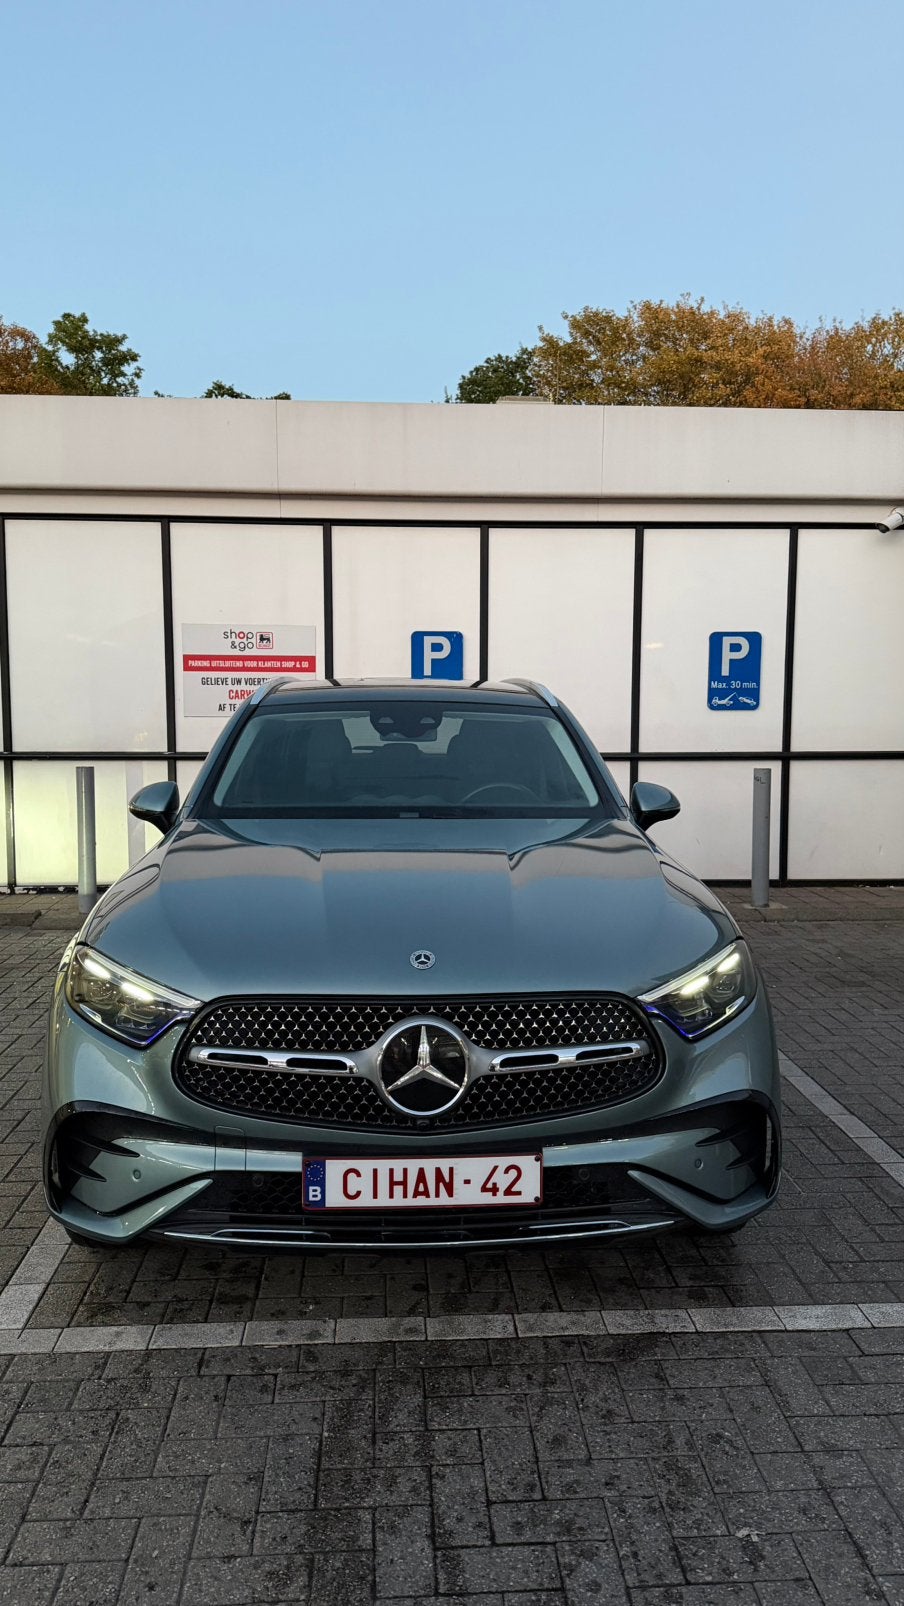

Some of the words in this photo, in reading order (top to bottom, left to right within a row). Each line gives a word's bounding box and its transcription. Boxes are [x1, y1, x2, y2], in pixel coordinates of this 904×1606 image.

[223, 629, 254, 641] shop
[230, 641, 254, 652] &go
[424, 636, 451, 676] P
[721, 636, 750, 676] P
[211, 660, 244, 668] UITSLUITEND
[201, 677, 229, 686] GELIEVE
[231, 677, 242, 686] UW
[711, 681, 729, 689] Max.
[730, 681, 741, 689] 30
[743, 681, 759, 689] min.
[218, 703, 227, 712] AF
[229, 704, 237, 712] TE
[308, 1186, 322, 1201] B
